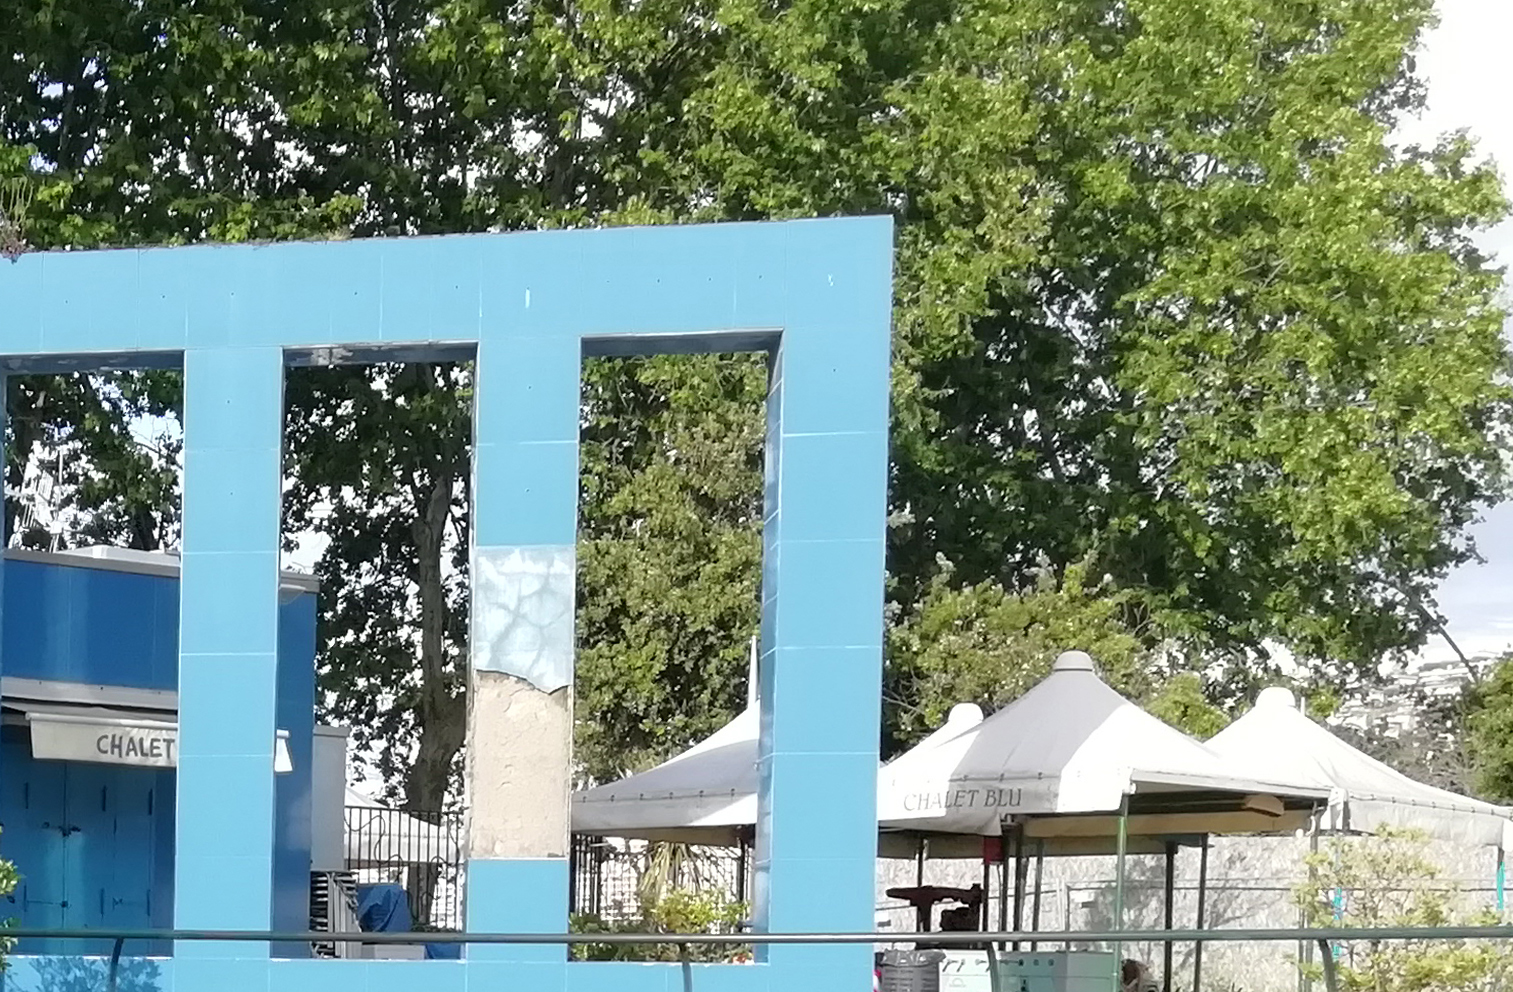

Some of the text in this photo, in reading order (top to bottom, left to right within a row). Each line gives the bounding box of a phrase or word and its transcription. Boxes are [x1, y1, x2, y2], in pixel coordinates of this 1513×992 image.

[96, 733, 176, 759] CHALET
[903, 788, 1022, 811] CHALET BLU
